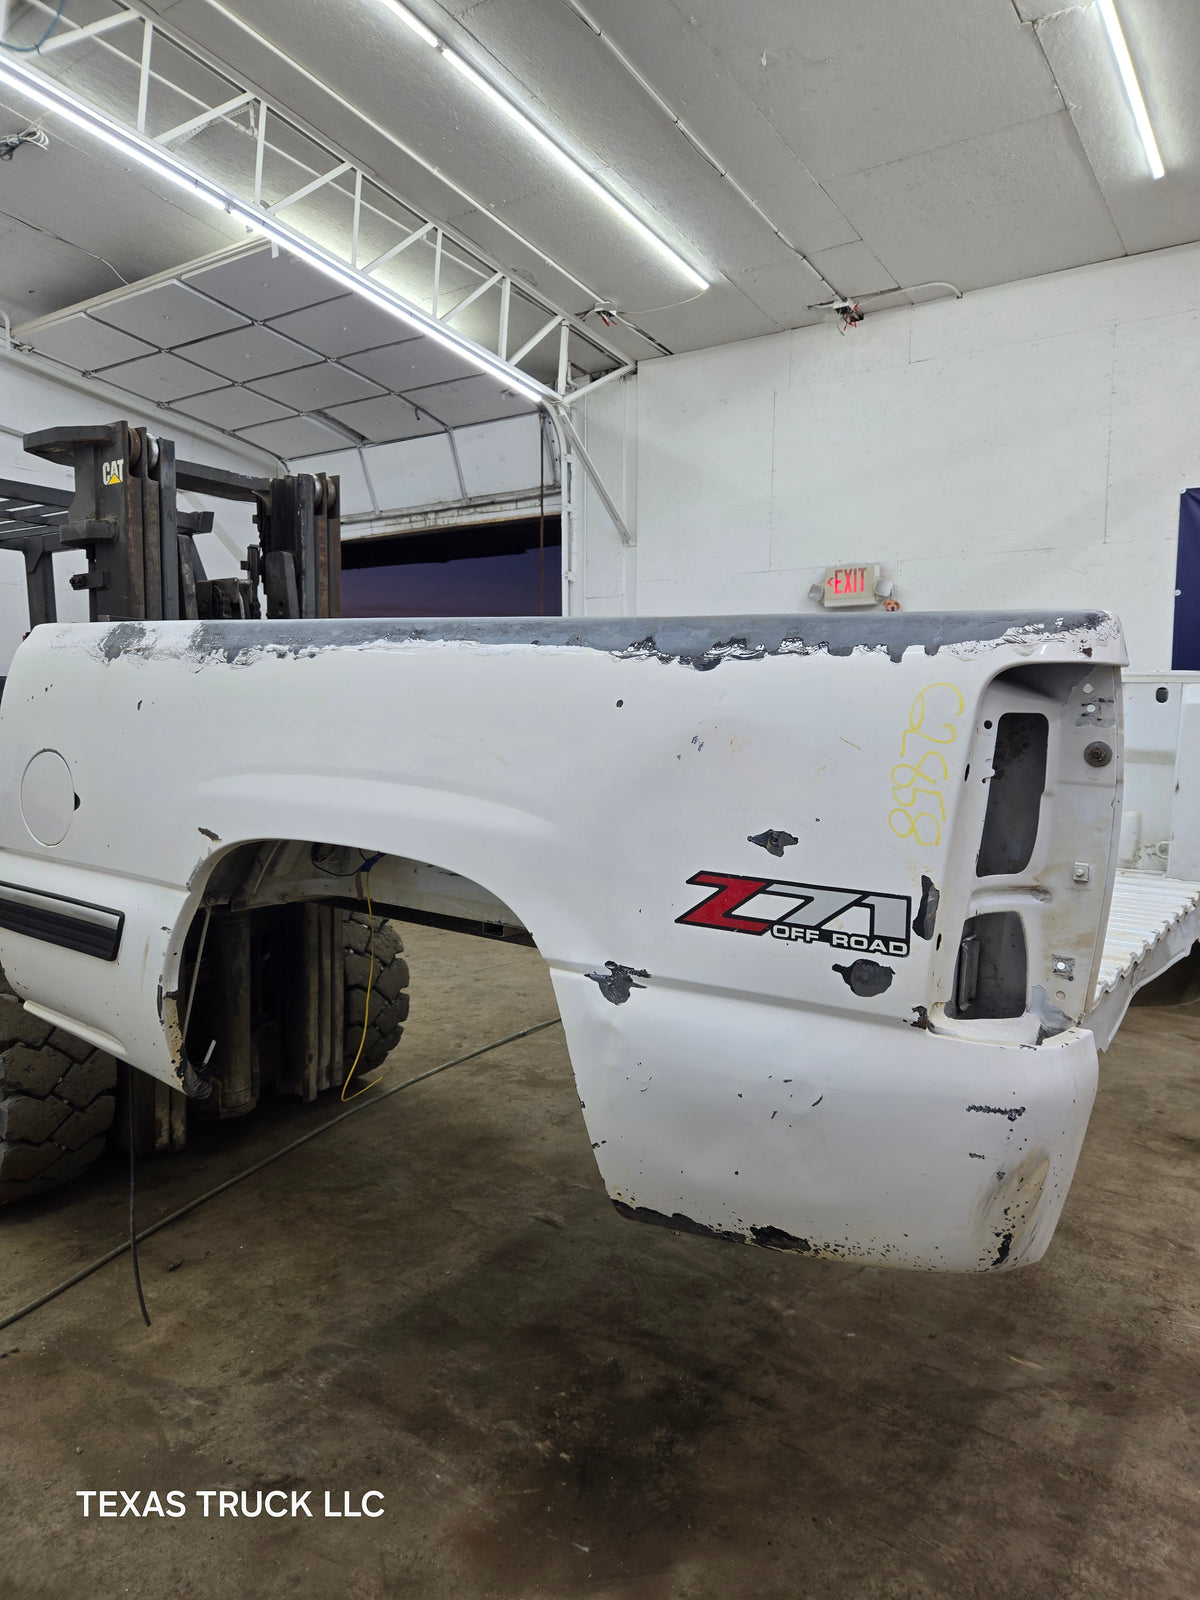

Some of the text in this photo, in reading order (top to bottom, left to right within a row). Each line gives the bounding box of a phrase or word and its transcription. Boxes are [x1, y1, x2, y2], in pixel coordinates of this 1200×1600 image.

[102, 458, 124, 486] CAT
[834, 567, 867, 595] EXIT
[674, 870, 912, 938] Z71
[771, 924, 908, 956] OFF ROAD
